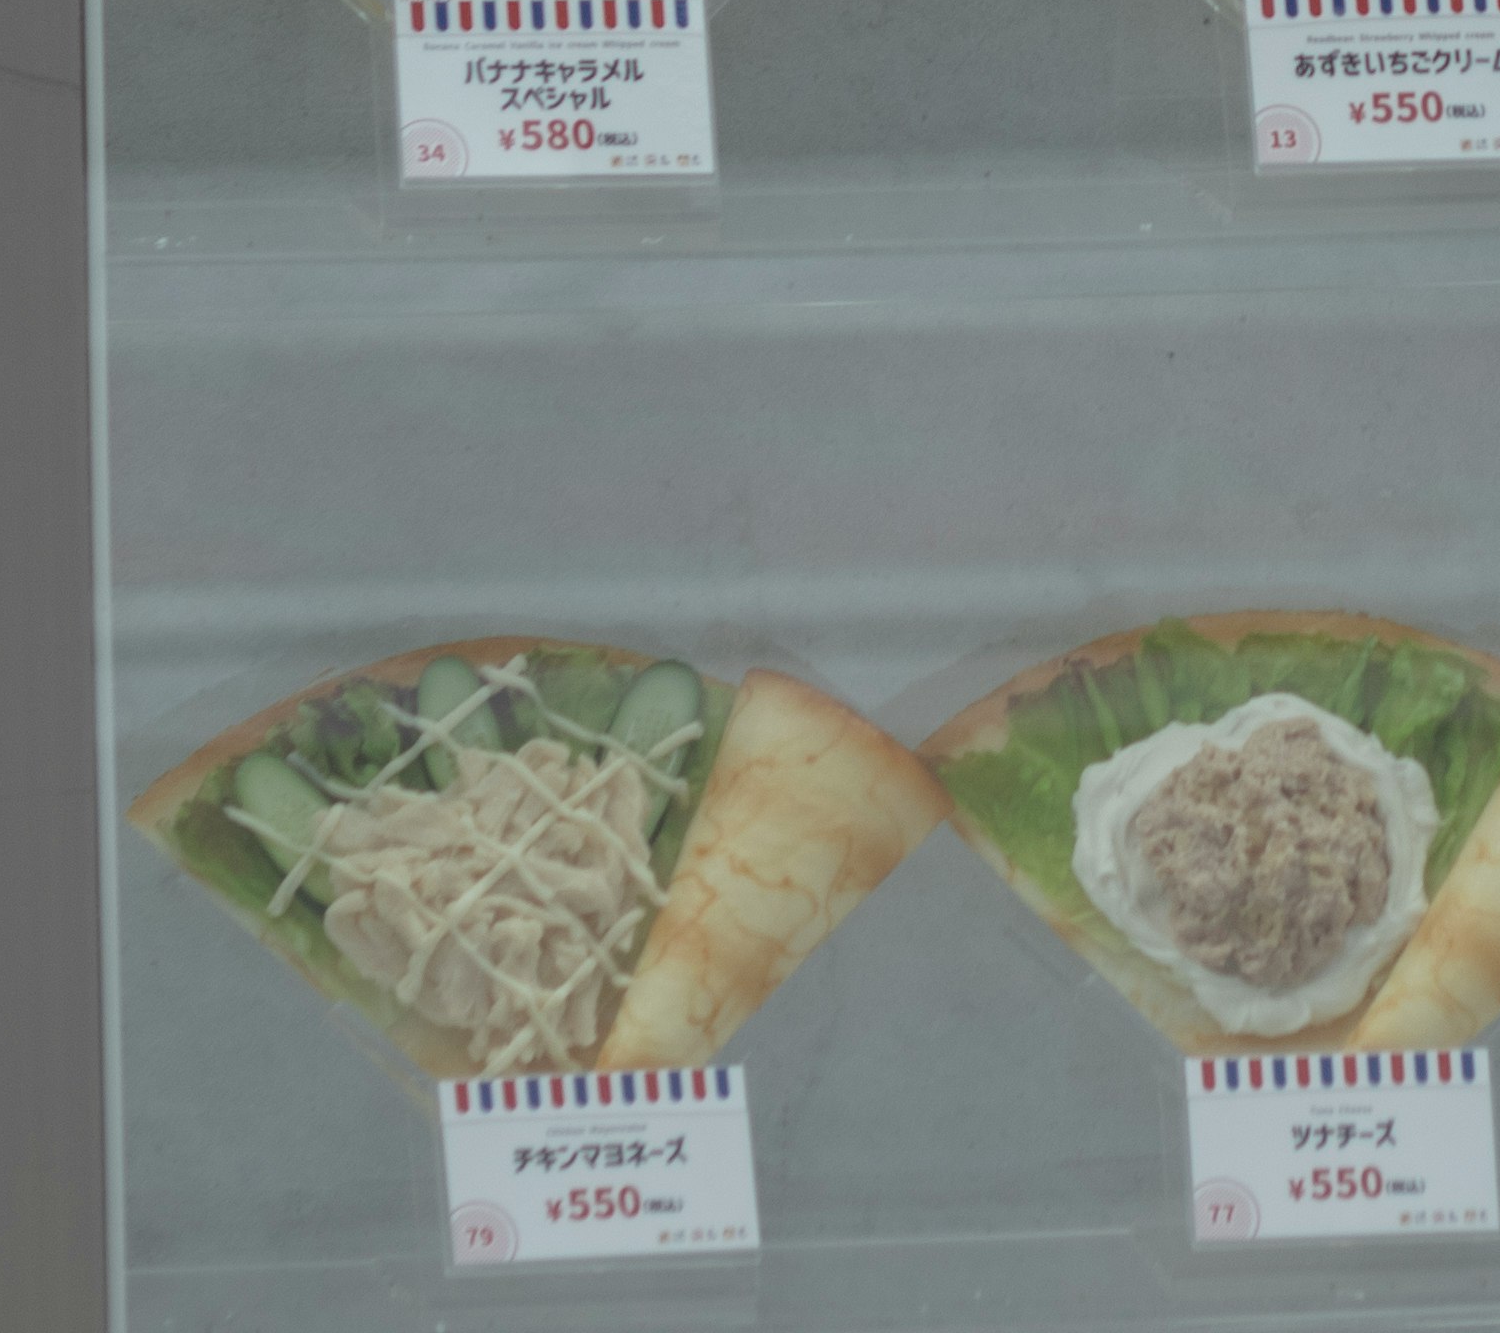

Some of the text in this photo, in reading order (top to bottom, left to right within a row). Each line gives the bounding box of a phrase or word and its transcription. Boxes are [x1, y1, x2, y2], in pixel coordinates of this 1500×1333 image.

[465, 58, 644, 83] バナナキャラメル
[501, 88, 611, 110] スペシャル
[1350, 91, 1443, 124] ¥550
[499, 120, 594, 151] ¥580
[1271, 131, 1296, 149] 13
[418, 145, 445, 162] 34
[1292, 1118, 1396, 1150] ツナチーズ
[514, 1136, 687, 1173] チキンマヨネーズ
[1290, 1166, 1383, 1201] ¥550
[547, 1186, 640, 1222] ¥550
[1211, 1204, 1234, 1224] 77
